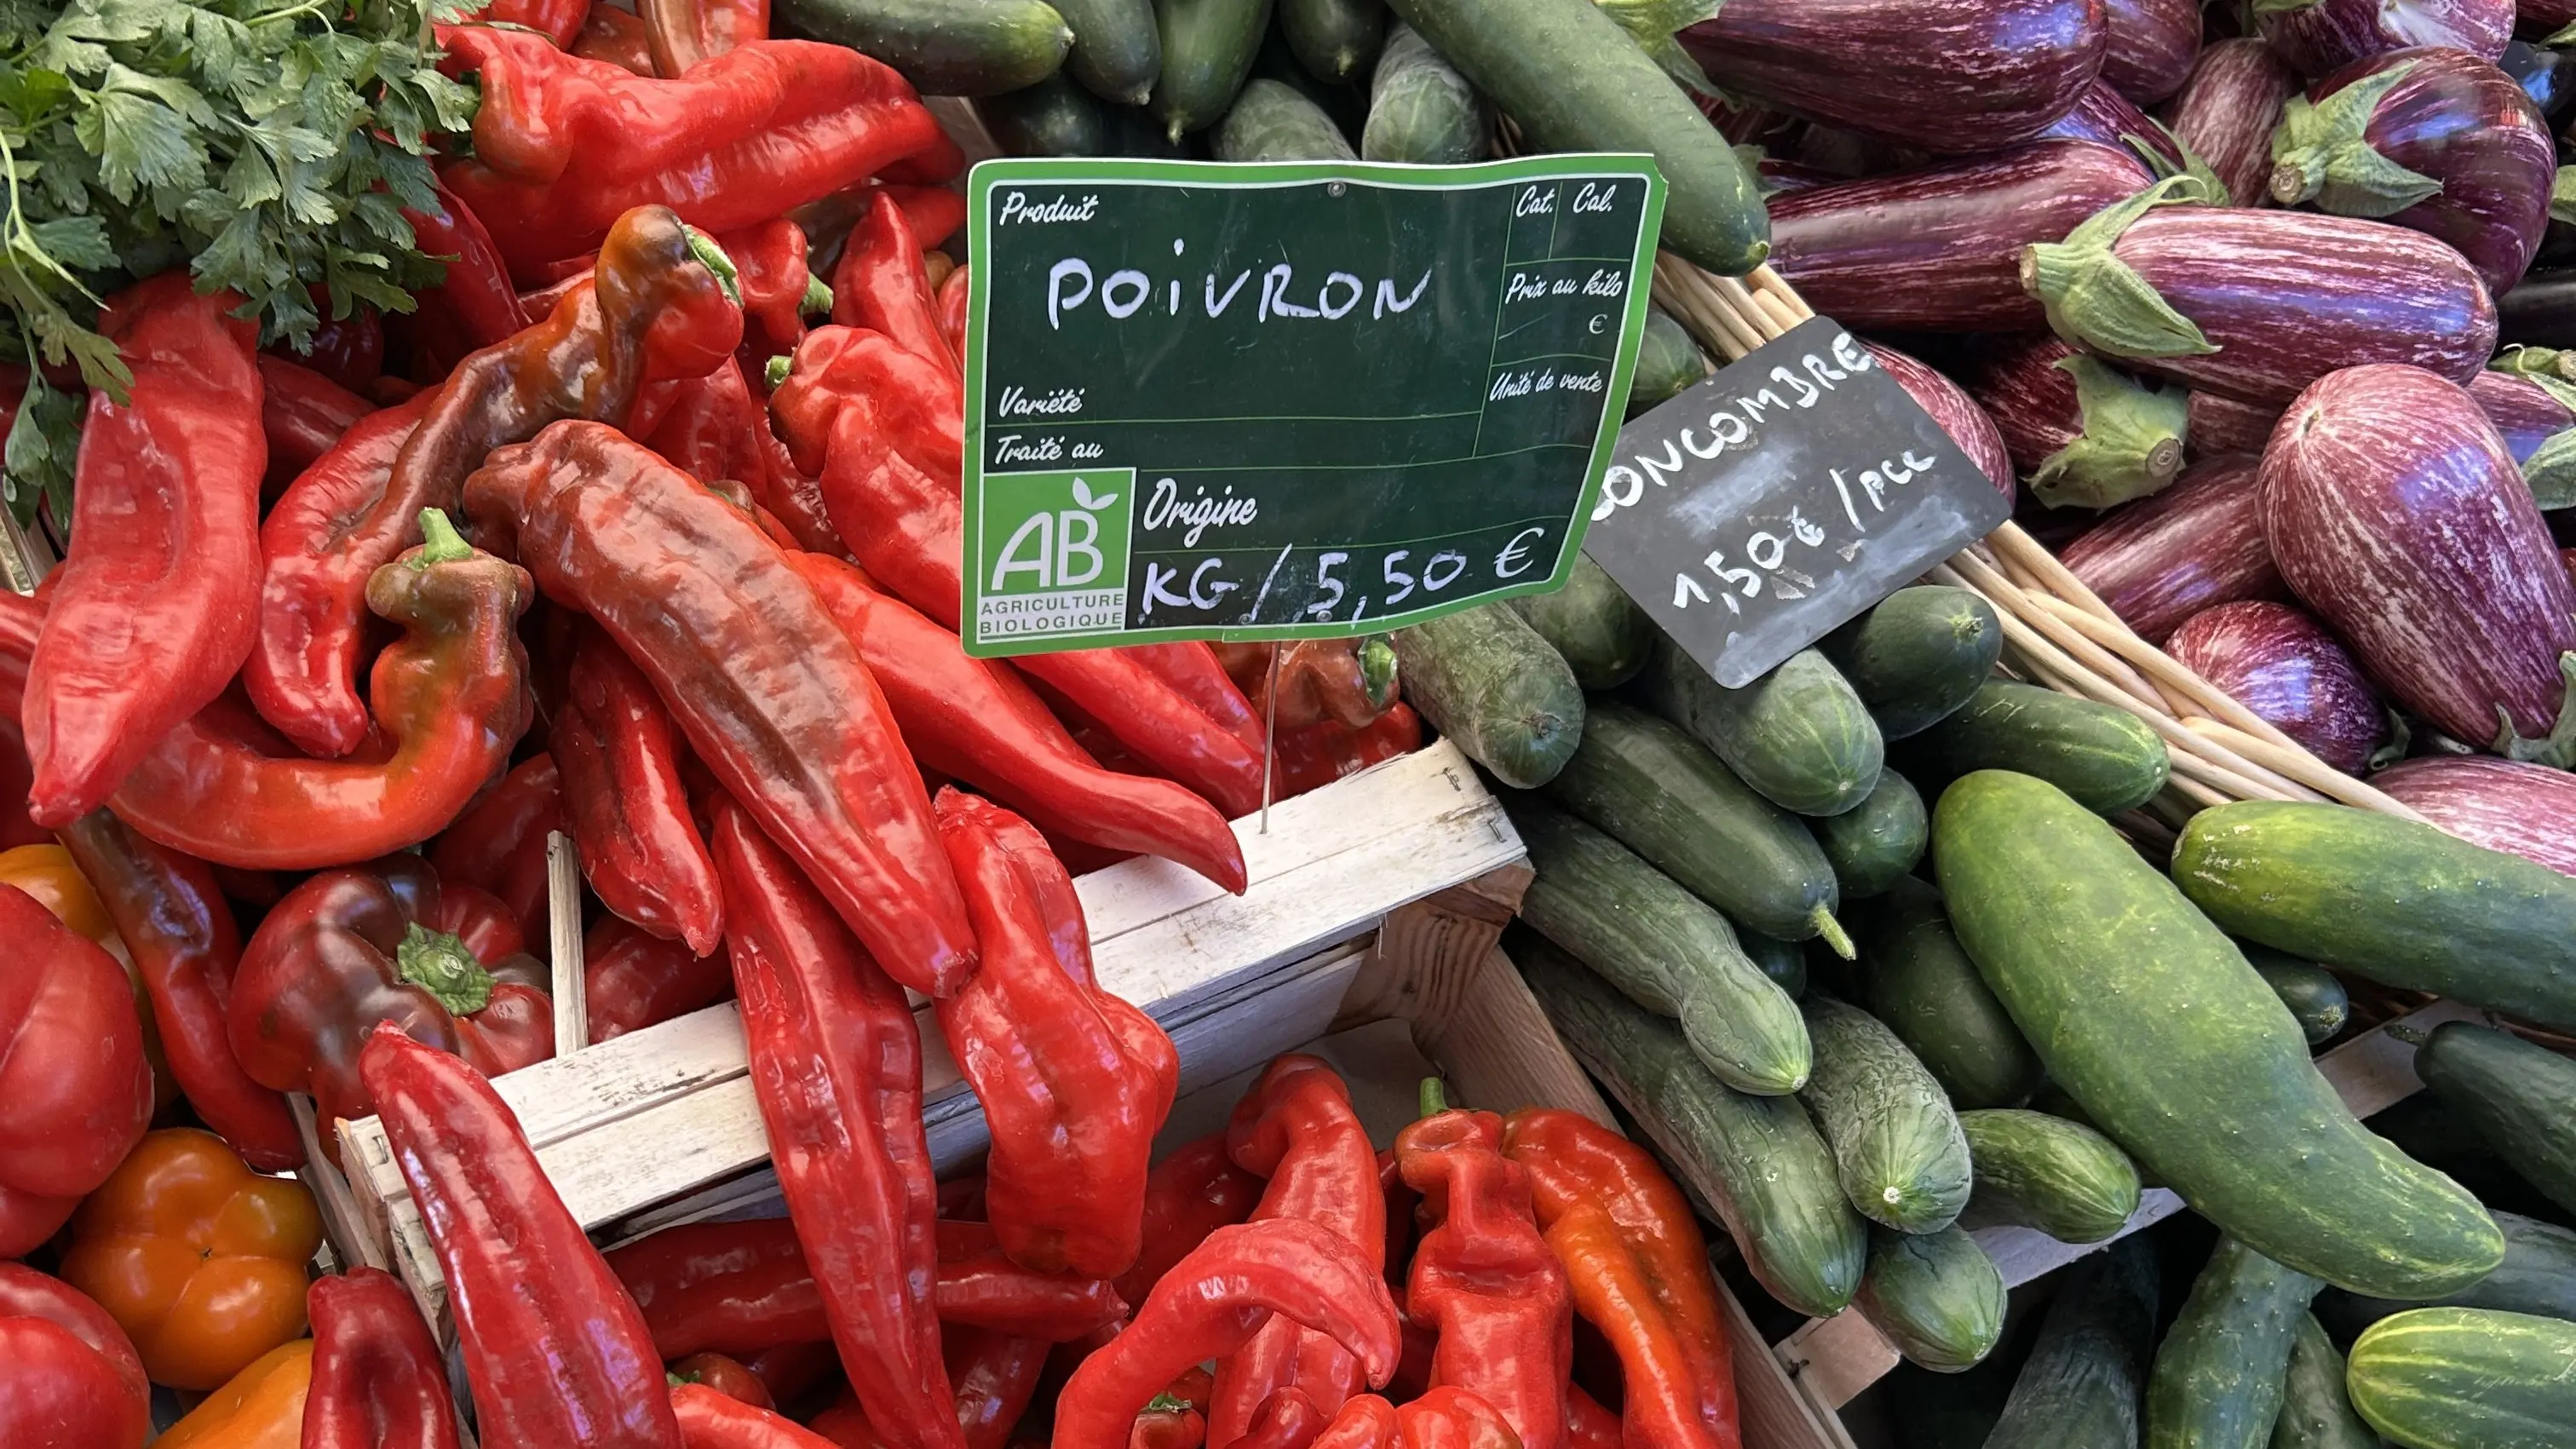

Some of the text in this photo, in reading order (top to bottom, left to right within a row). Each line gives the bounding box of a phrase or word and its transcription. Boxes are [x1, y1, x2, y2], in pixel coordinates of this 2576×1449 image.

[999, 192, 1099, 226] Produit
[1515, 185, 1555, 217] Cat.
[1573, 182, 1617, 214] Cal.
[1504, 268, 1624, 305] Prix au kilo
[1588, 313, 1608, 335] €
[1489, 367, 1604, 401] Unité de vente
[998, 386, 1086, 418] Variété
[994, 434, 1104, 465] Traité au
[1143, 477, 1258, 549] Origine
[991, 509, 1104, 591] AB
[1492, 526, 1544, 578] €
[980, 593, 1124, 616] AGRICULTURE
[980, 612, 1123, 634] BIOLOGIQUE
